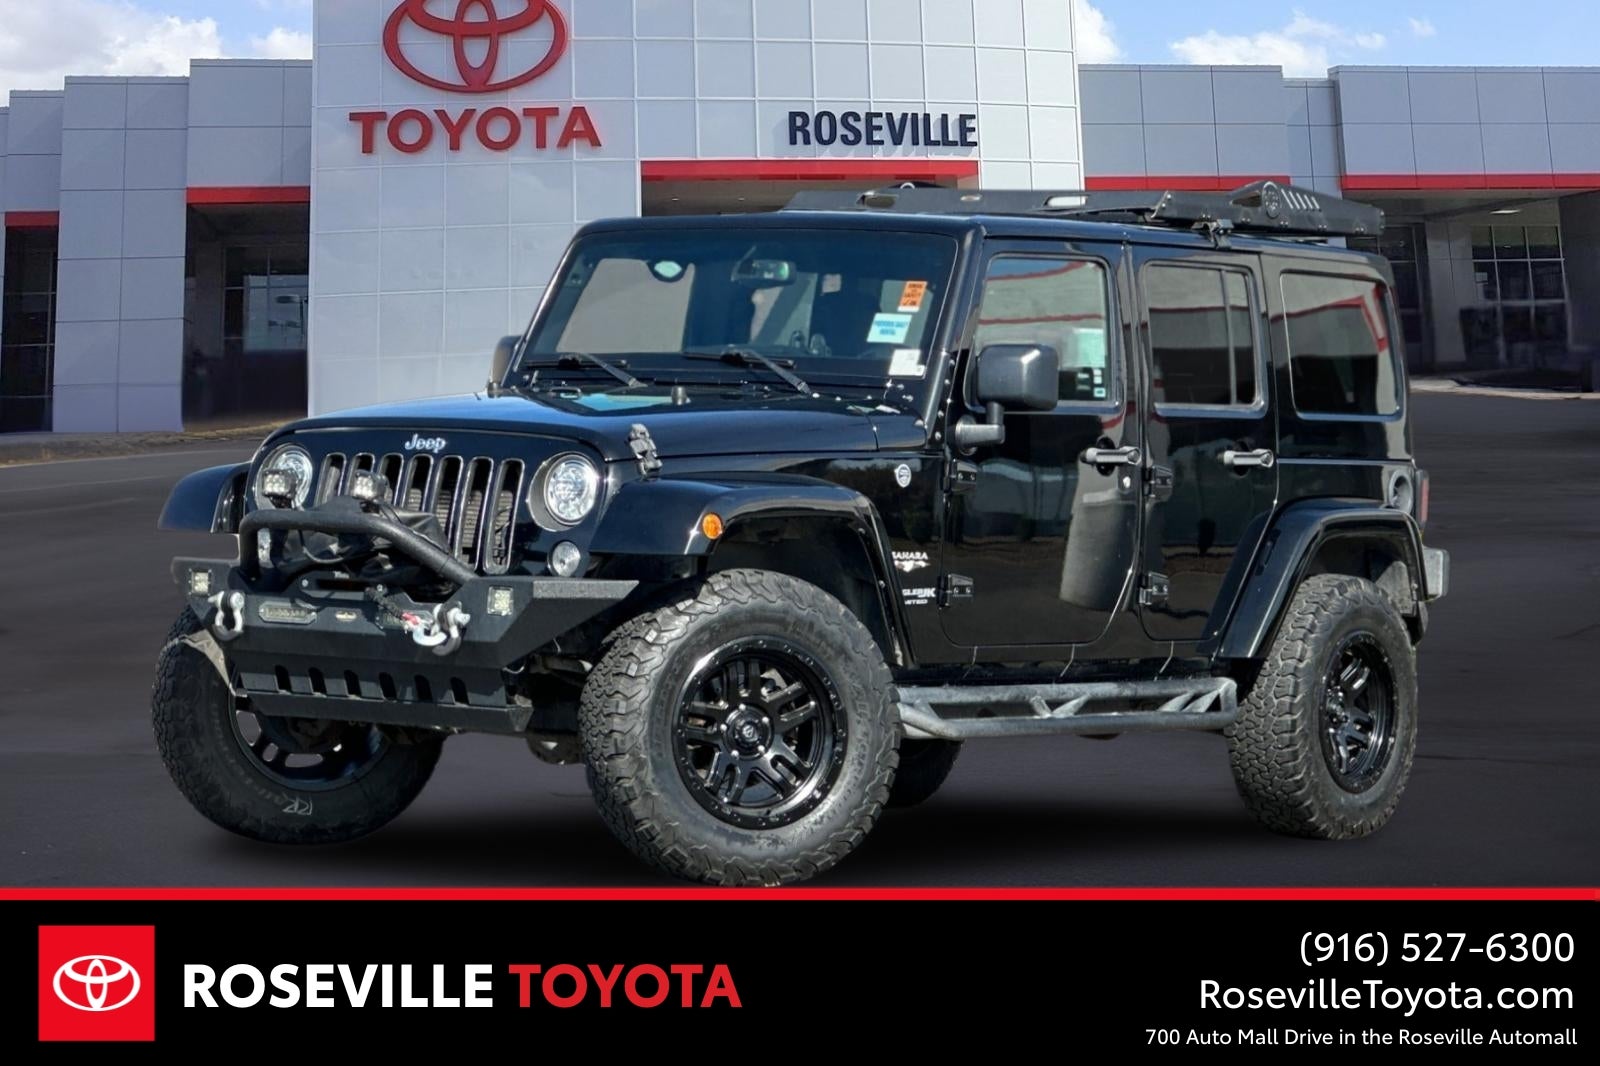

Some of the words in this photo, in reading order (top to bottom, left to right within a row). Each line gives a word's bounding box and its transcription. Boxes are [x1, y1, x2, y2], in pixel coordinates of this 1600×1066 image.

[348, 106, 602, 154] TOYOTA
[788, 110, 978, 147] ROSEVILLE
[404, 433, 446, 454] Jeep
